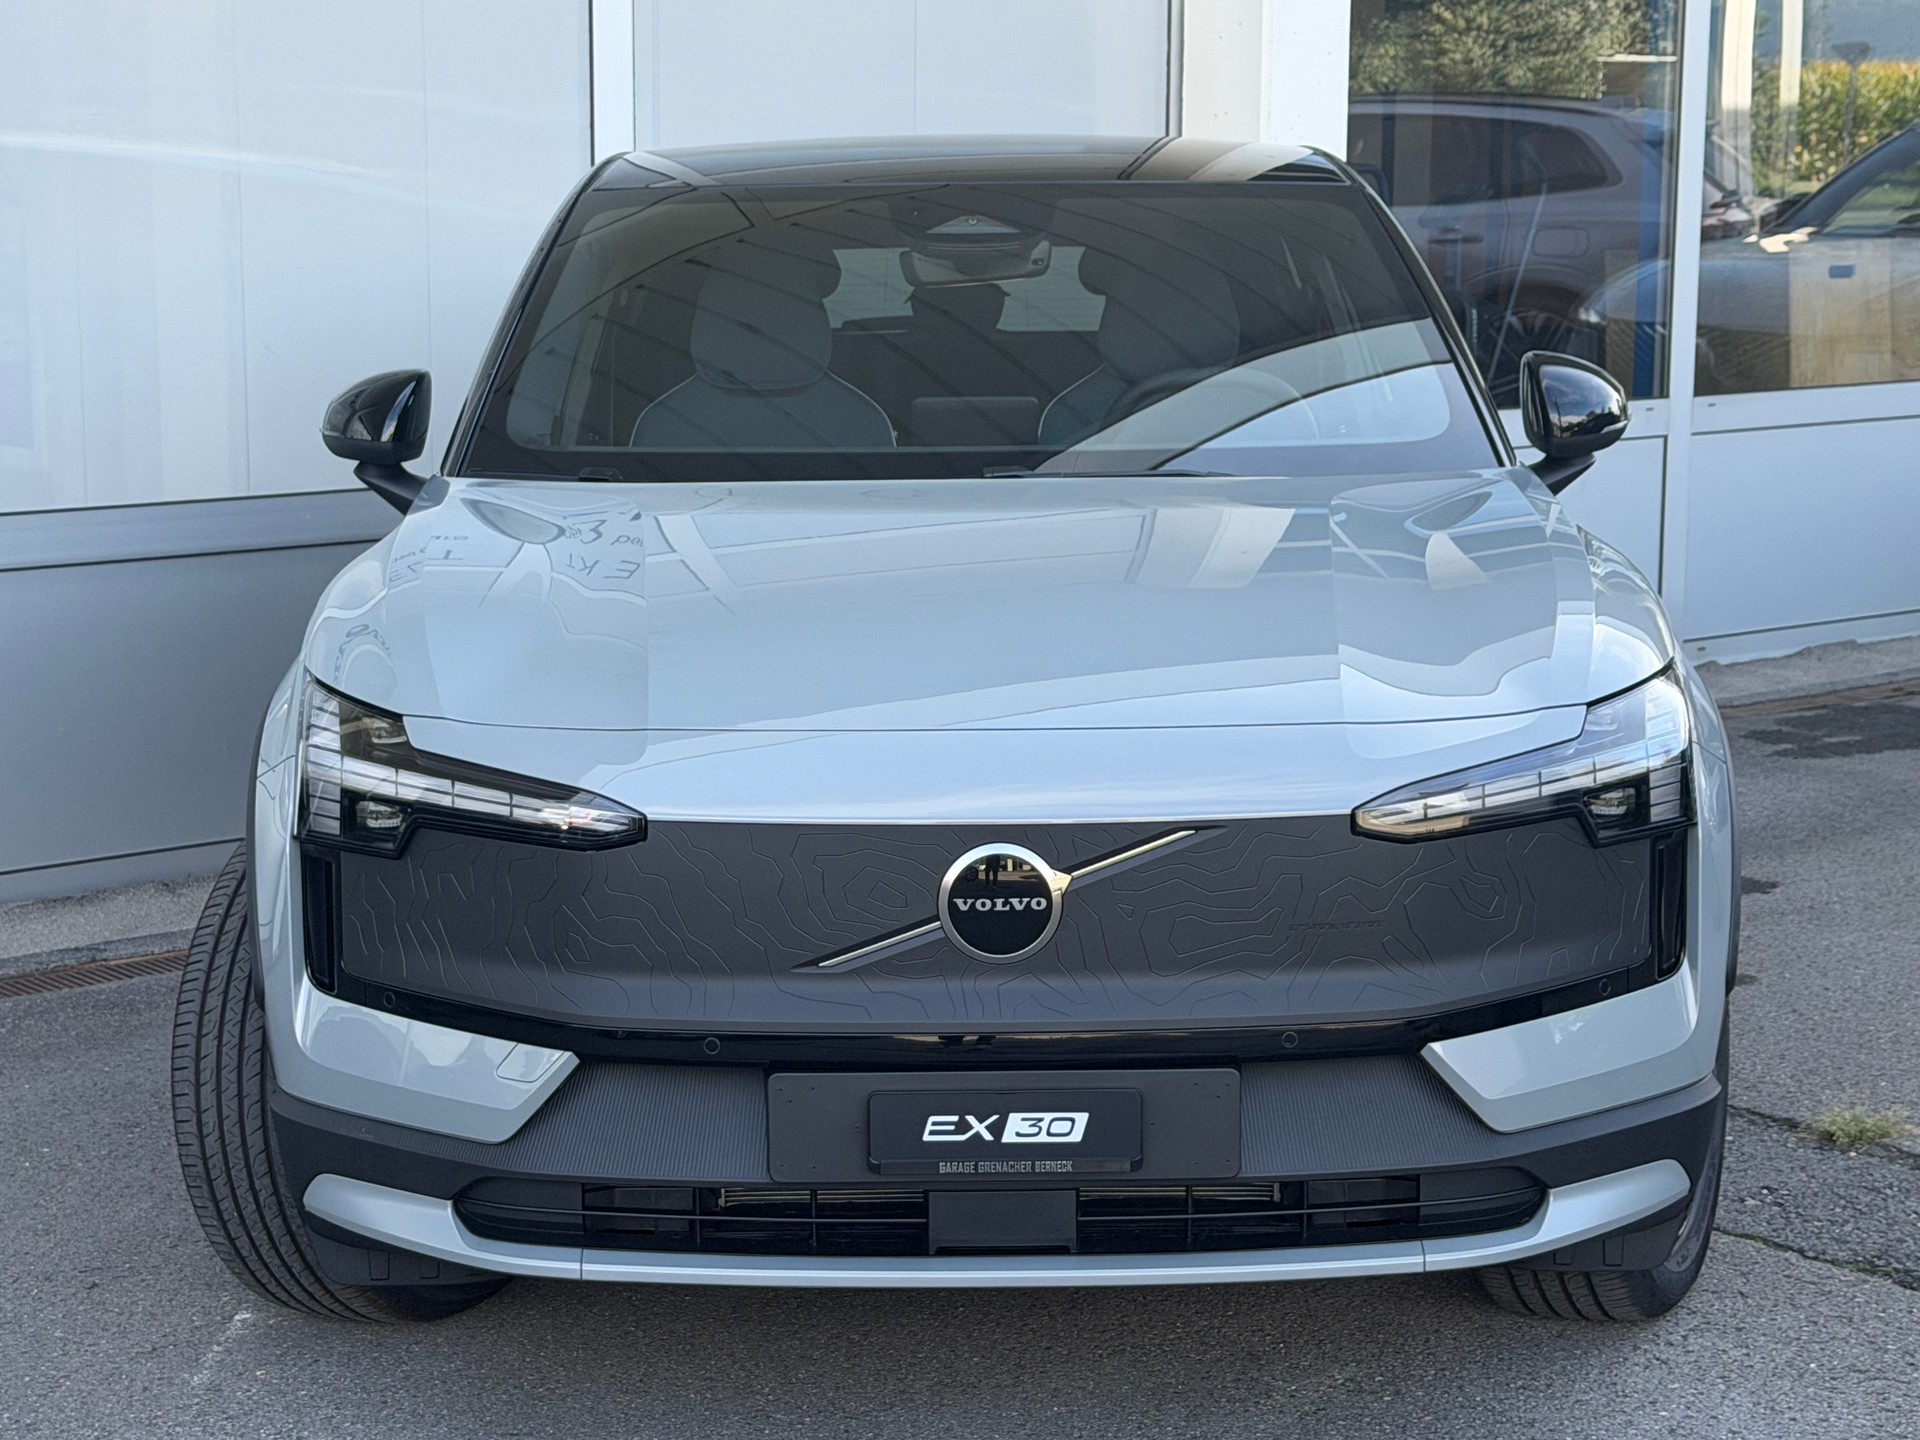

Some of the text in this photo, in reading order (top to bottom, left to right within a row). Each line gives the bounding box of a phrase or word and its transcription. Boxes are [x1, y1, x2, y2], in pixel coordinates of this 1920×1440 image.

[952, 897, 1048, 912] VOLVO
[939, 1160, 1074, 1174] GARAGE GRENACHER BERNECK
